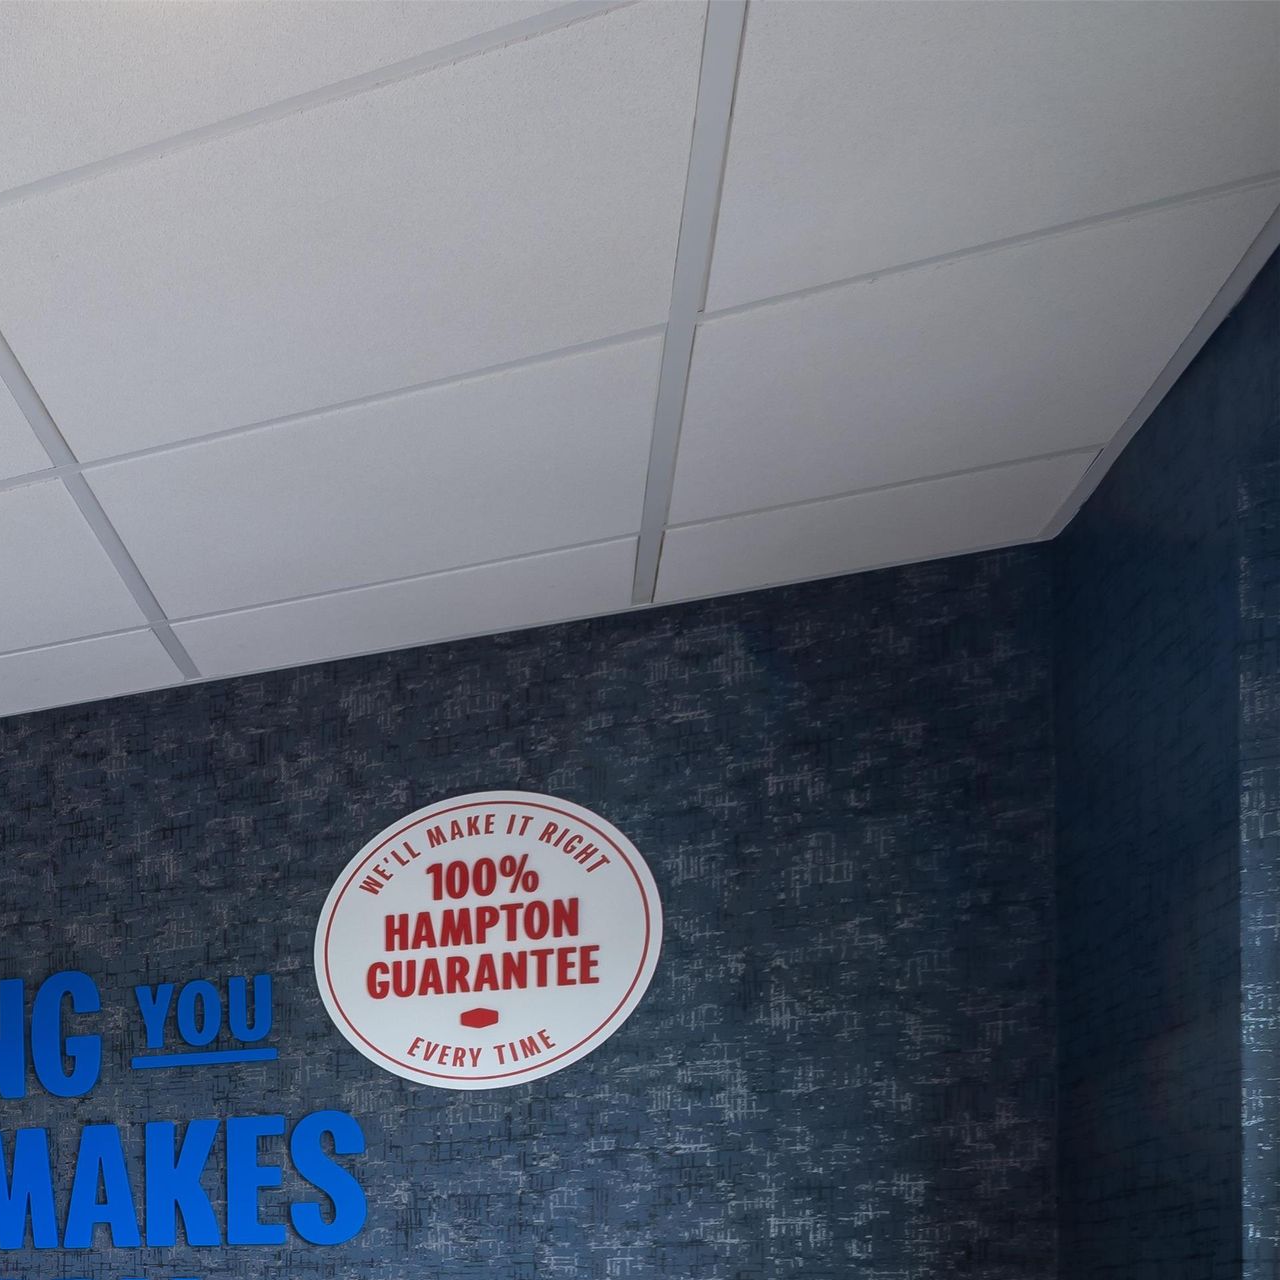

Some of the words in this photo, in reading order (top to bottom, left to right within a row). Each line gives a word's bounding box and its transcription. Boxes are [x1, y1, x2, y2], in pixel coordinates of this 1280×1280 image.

[358, 840, 421, 896] WE'LL
[426, 813, 496, 849] MAKE
[506, 814, 534, 836] IT
[538, 821, 612, 874] RIGHT
[426, 853, 539, 901] 100%
[384, 897, 579, 952] HAMPTON
[366, 944, 600, 999] GUARANTEE
[136, 975, 276, 1049] YOU
[407, 1036, 482, 1068] EVERY
[493, 1028, 556, 1065] TIME
